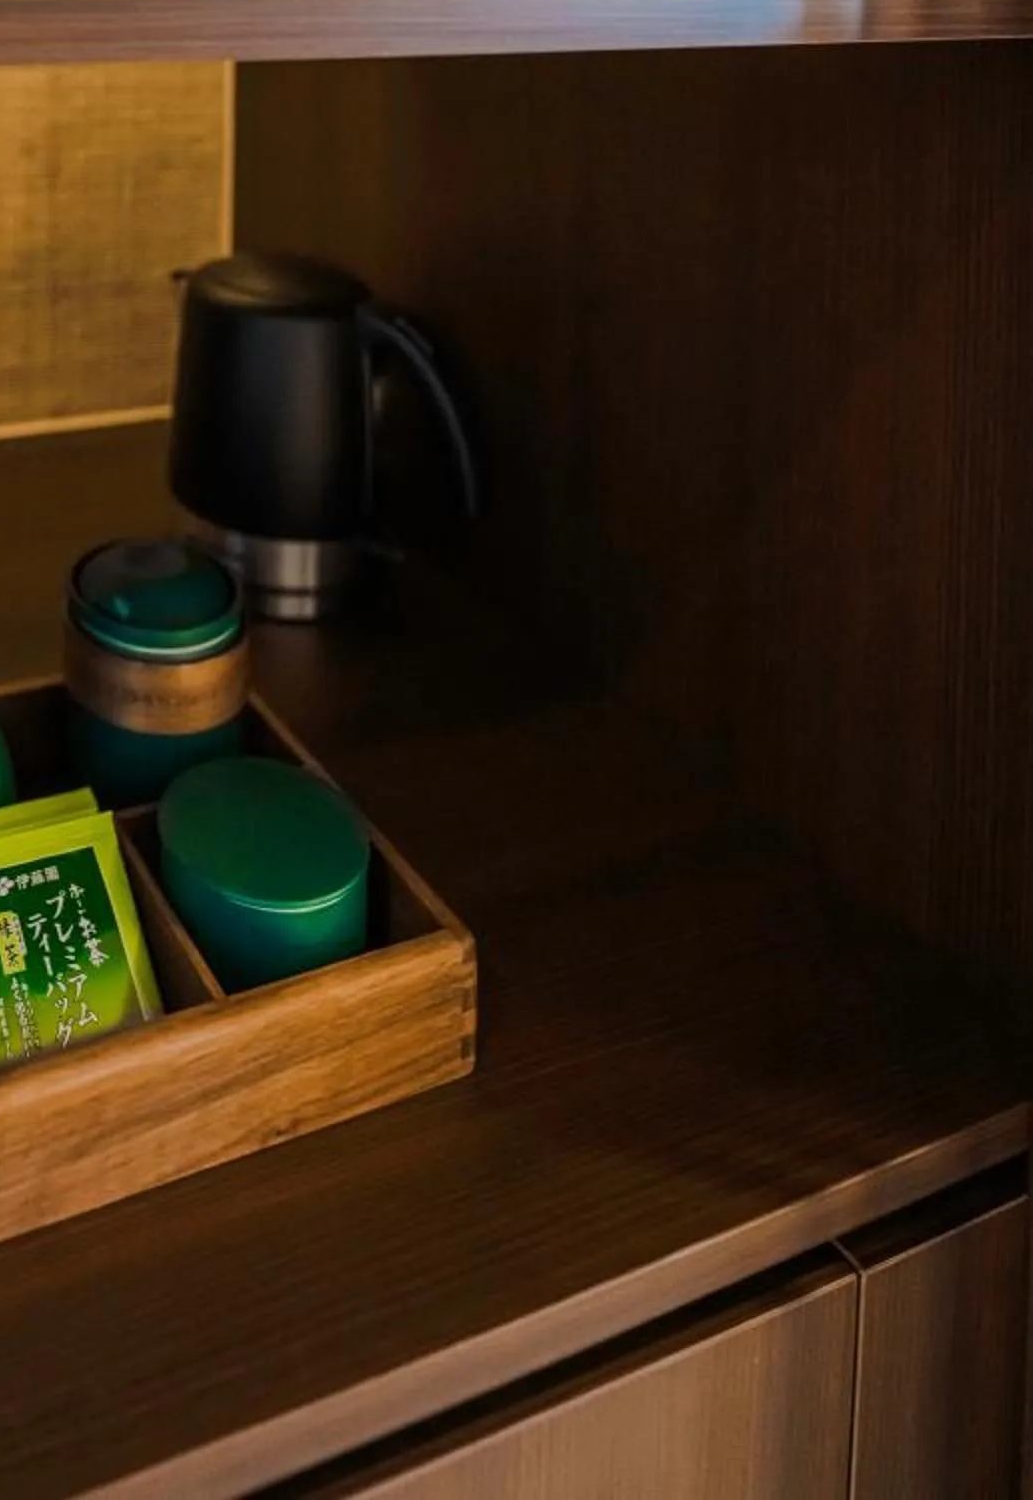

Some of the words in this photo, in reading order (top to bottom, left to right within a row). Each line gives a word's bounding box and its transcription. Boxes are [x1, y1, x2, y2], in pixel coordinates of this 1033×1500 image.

[15, 865, 60, 890] 伊藤園
[27, 913, 73, 1048] ティーバッグ
[45, 889, 98, 1026] プレミアム
